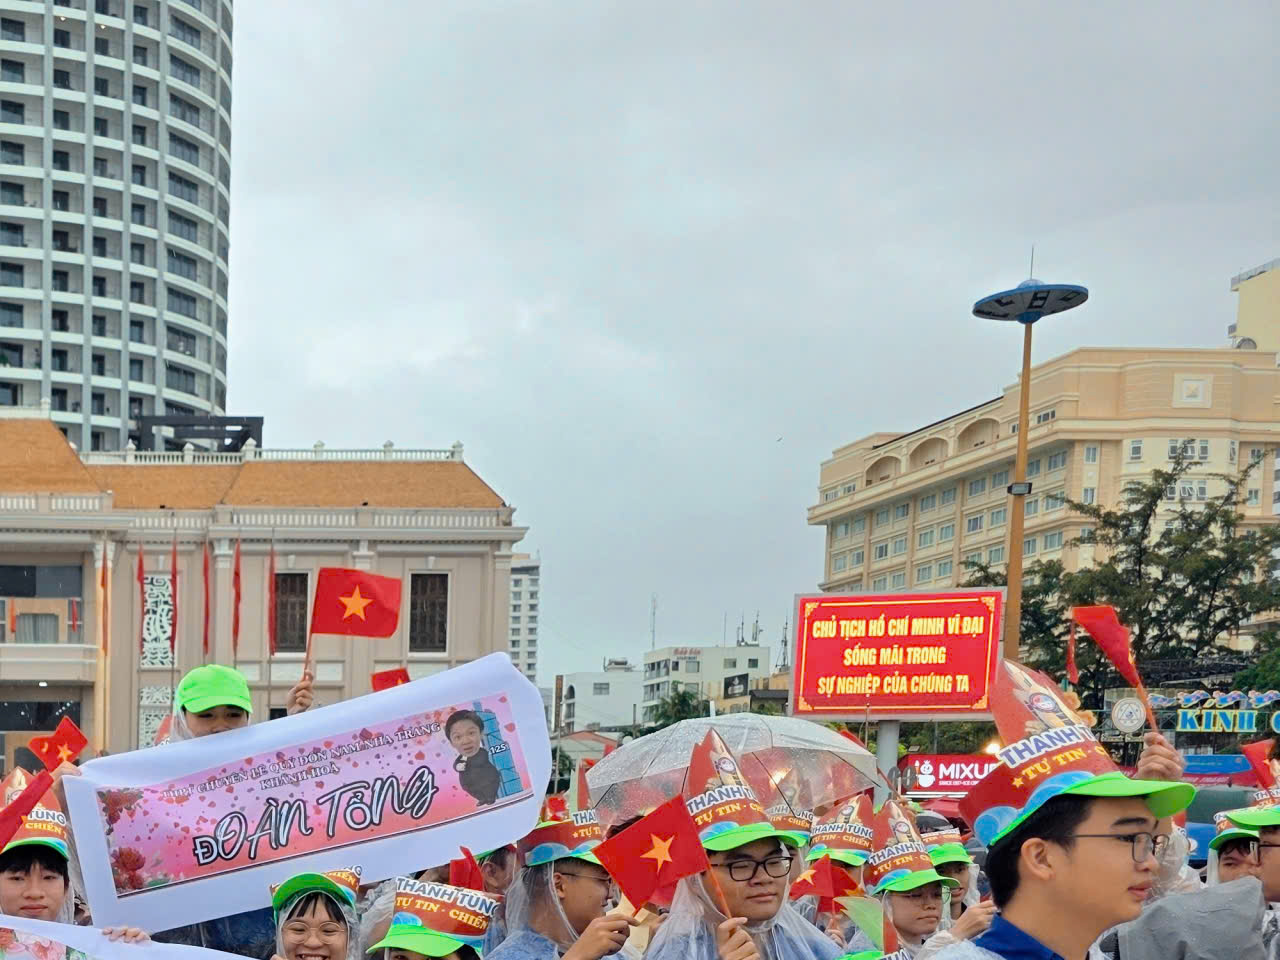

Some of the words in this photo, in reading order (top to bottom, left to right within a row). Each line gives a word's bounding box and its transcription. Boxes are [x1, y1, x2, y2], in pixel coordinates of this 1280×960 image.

[813, 615, 837, 638] CHỦ
[840, 619, 866, 640] TỊCH
[888, 615, 910, 636] CHÍ
[911, 617, 945, 636] MINH
[962, 616, 984, 638] ĐẠI
[843, 643, 877, 666] SỐNG
[879, 644, 903, 665] MÃI
[906, 646, 947, 665] TRONG
[817, 676, 836, 698] SỰ
[837, 672, 880, 698] NGHIỆP
[883, 670, 908, 694] CỦA
[911, 672, 952, 693] CHÚNG
[956, 674, 970, 693] TA
[330, 740, 362, 760] NAM
[395, 722, 442, 743] TRANG
[999, 726, 1078, 766] THANH
[1021, 757, 1052, 779] TỰ
[1052, 747, 1087, 766] TIN
[686, 785, 745, 814] THANH
[715, 802, 742, 817] TIN
[573, 809, 596, 825] THA
[396, 877, 455, 903] THANH
[396, 896, 414, 912] TỰ
[415, 898, 440, 914] TIN
[448, 908, 489, 931] CHIẾN
